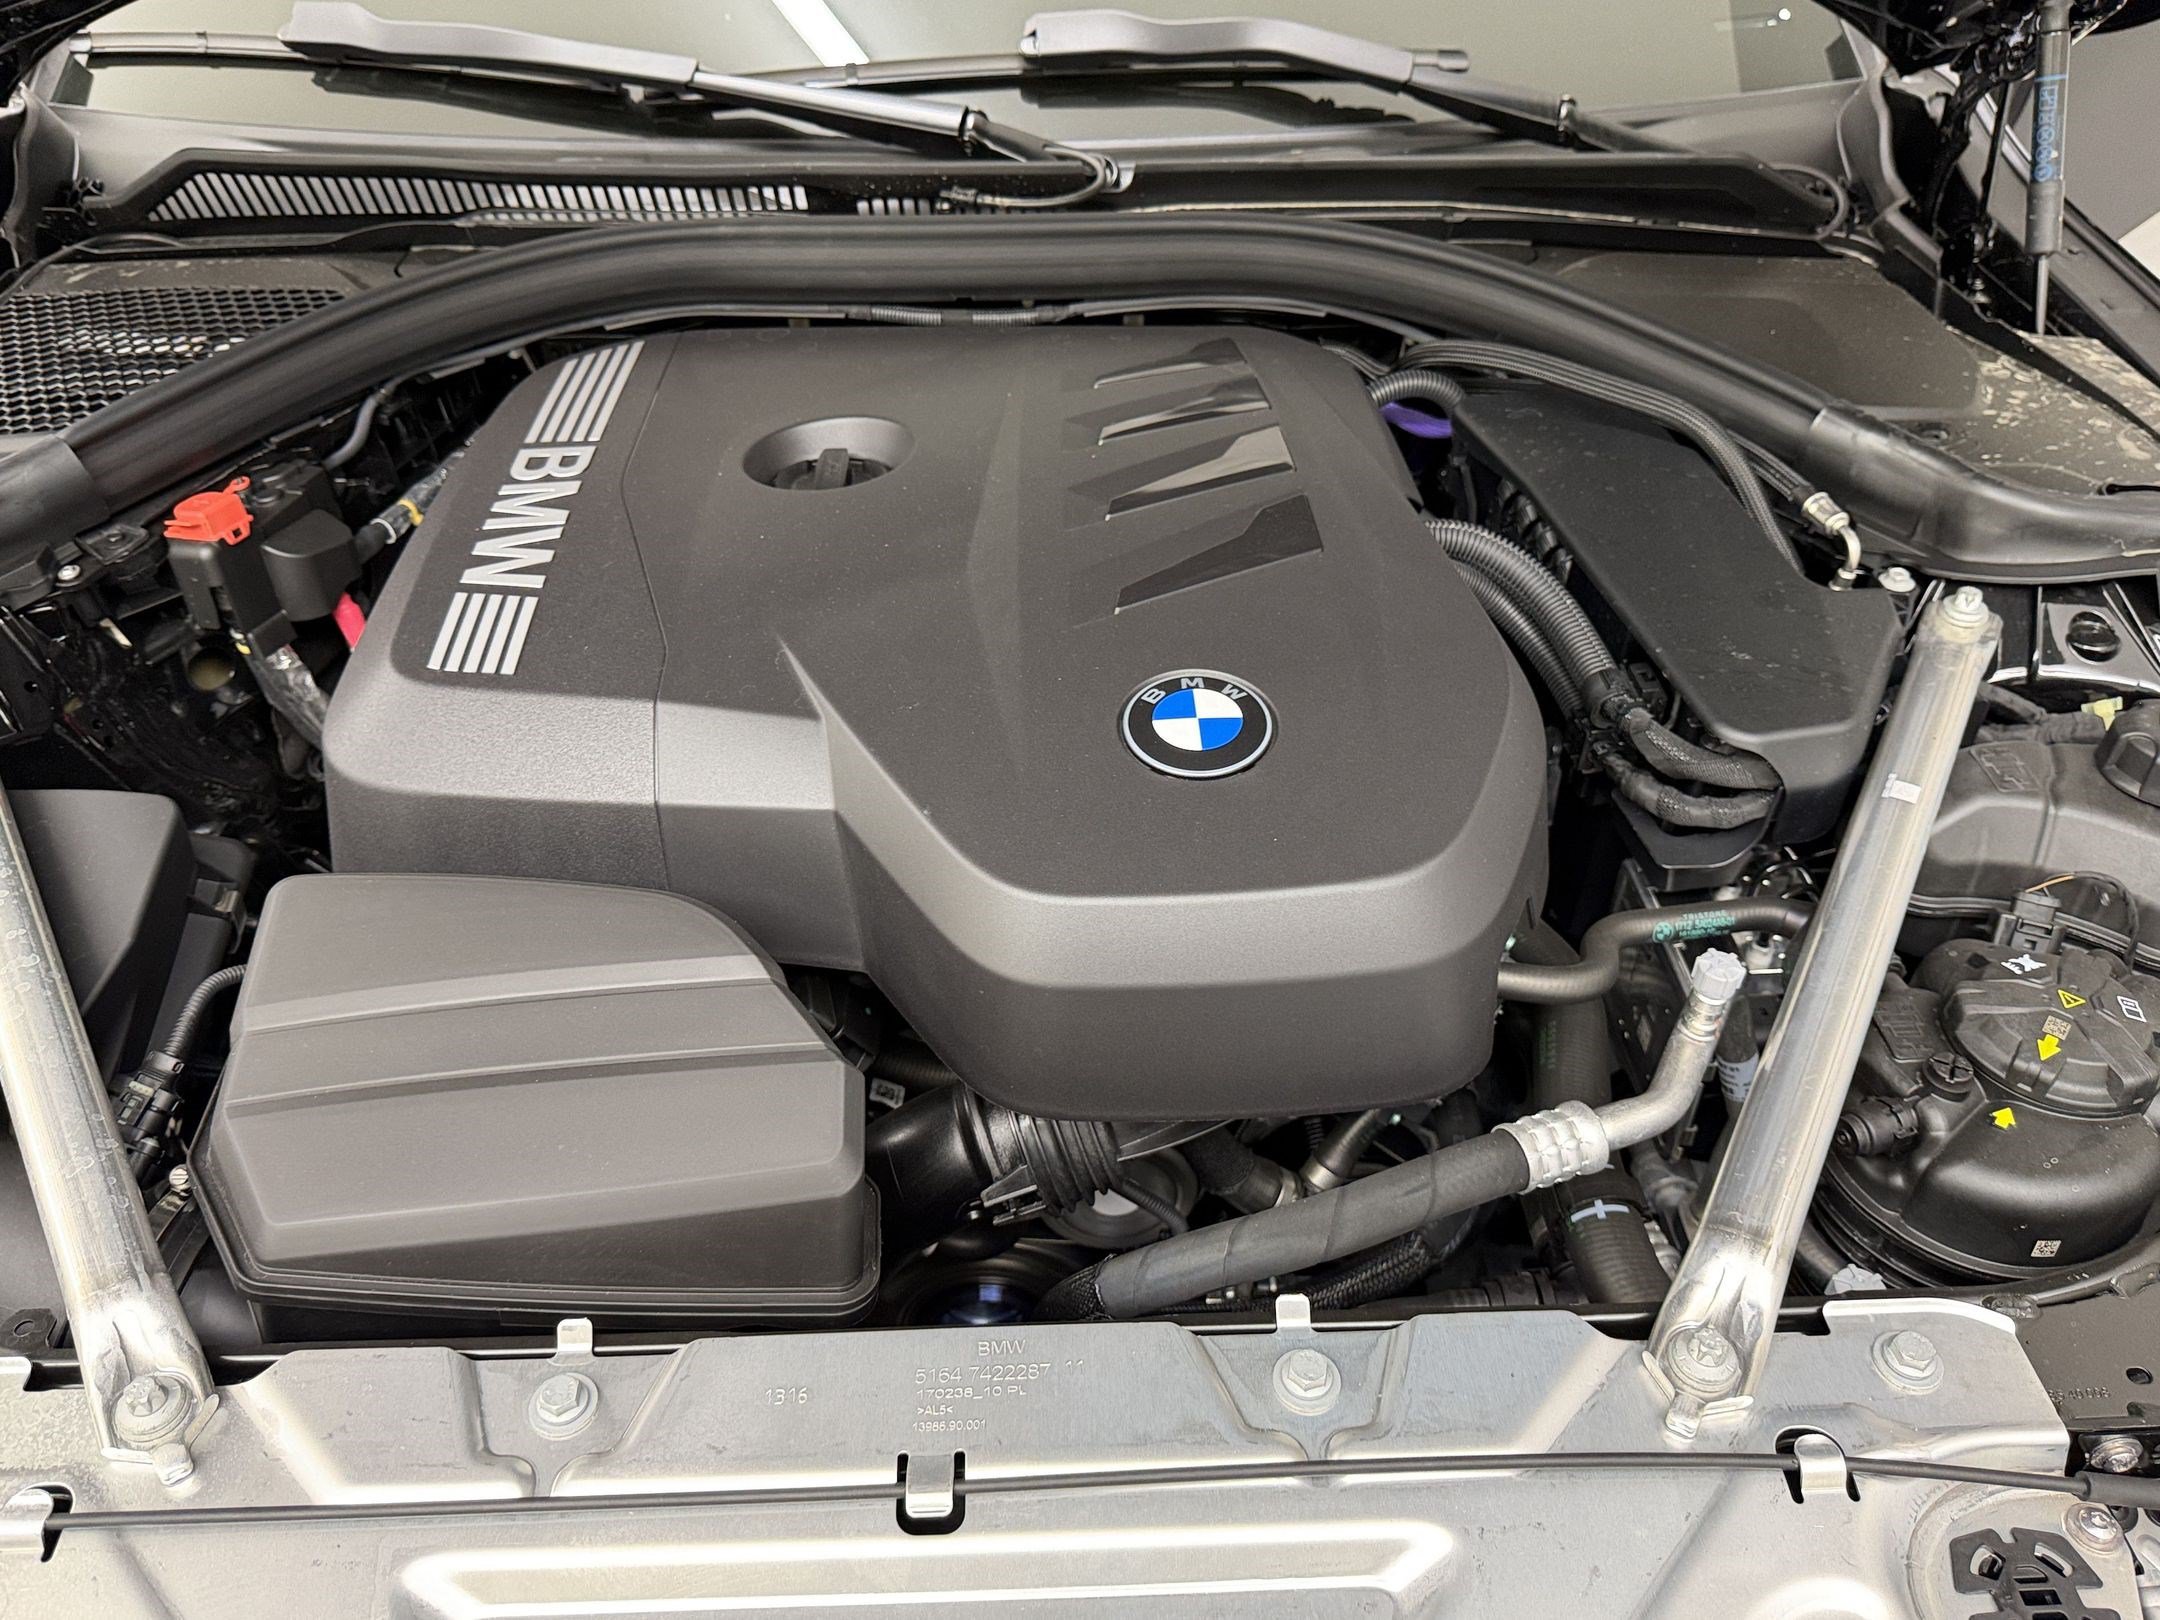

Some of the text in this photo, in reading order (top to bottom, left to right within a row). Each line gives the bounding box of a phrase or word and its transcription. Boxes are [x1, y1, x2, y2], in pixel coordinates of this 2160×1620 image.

[458, 445, 597, 589] BMW
[1141, 677, 1248, 705] BMW
[978, 1339, 1026, 1356] BMW
[914, 1367, 962, 1384] 5164
[968, 1362, 1051, 1382] 7422287
[765, 1387, 808, 1405] 1316
[916, 1384, 1027, 1400] 170238_10 PL
